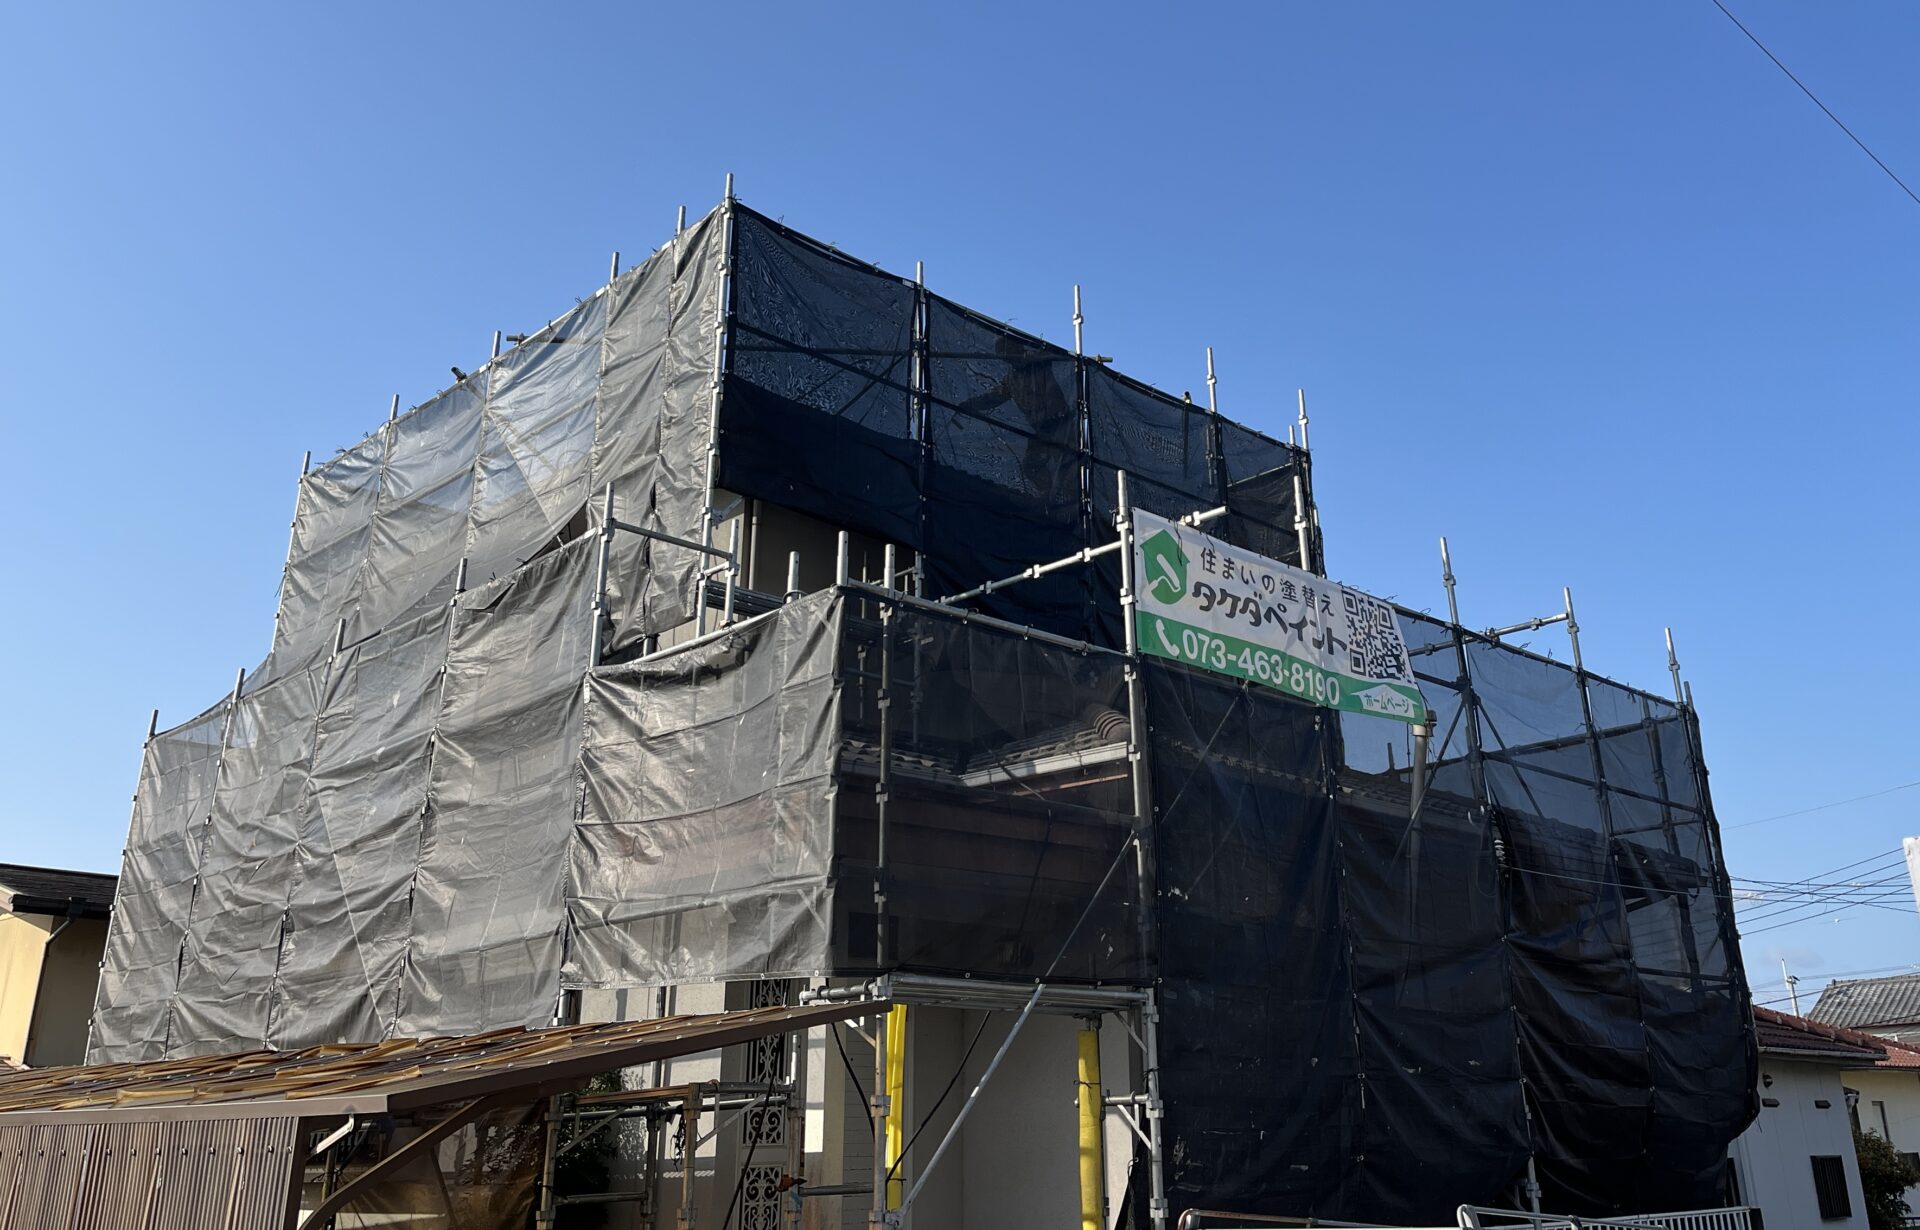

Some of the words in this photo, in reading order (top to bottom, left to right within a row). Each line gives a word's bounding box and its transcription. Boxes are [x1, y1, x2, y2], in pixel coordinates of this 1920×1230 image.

[1200, 547, 1334, 616] 住まいの塗替え
[1192, 581, 1347, 655] タケダペイント
[1182, 629, 1340, 706] 073-463-8190
[1363, 693, 1410, 714] ホームページ
